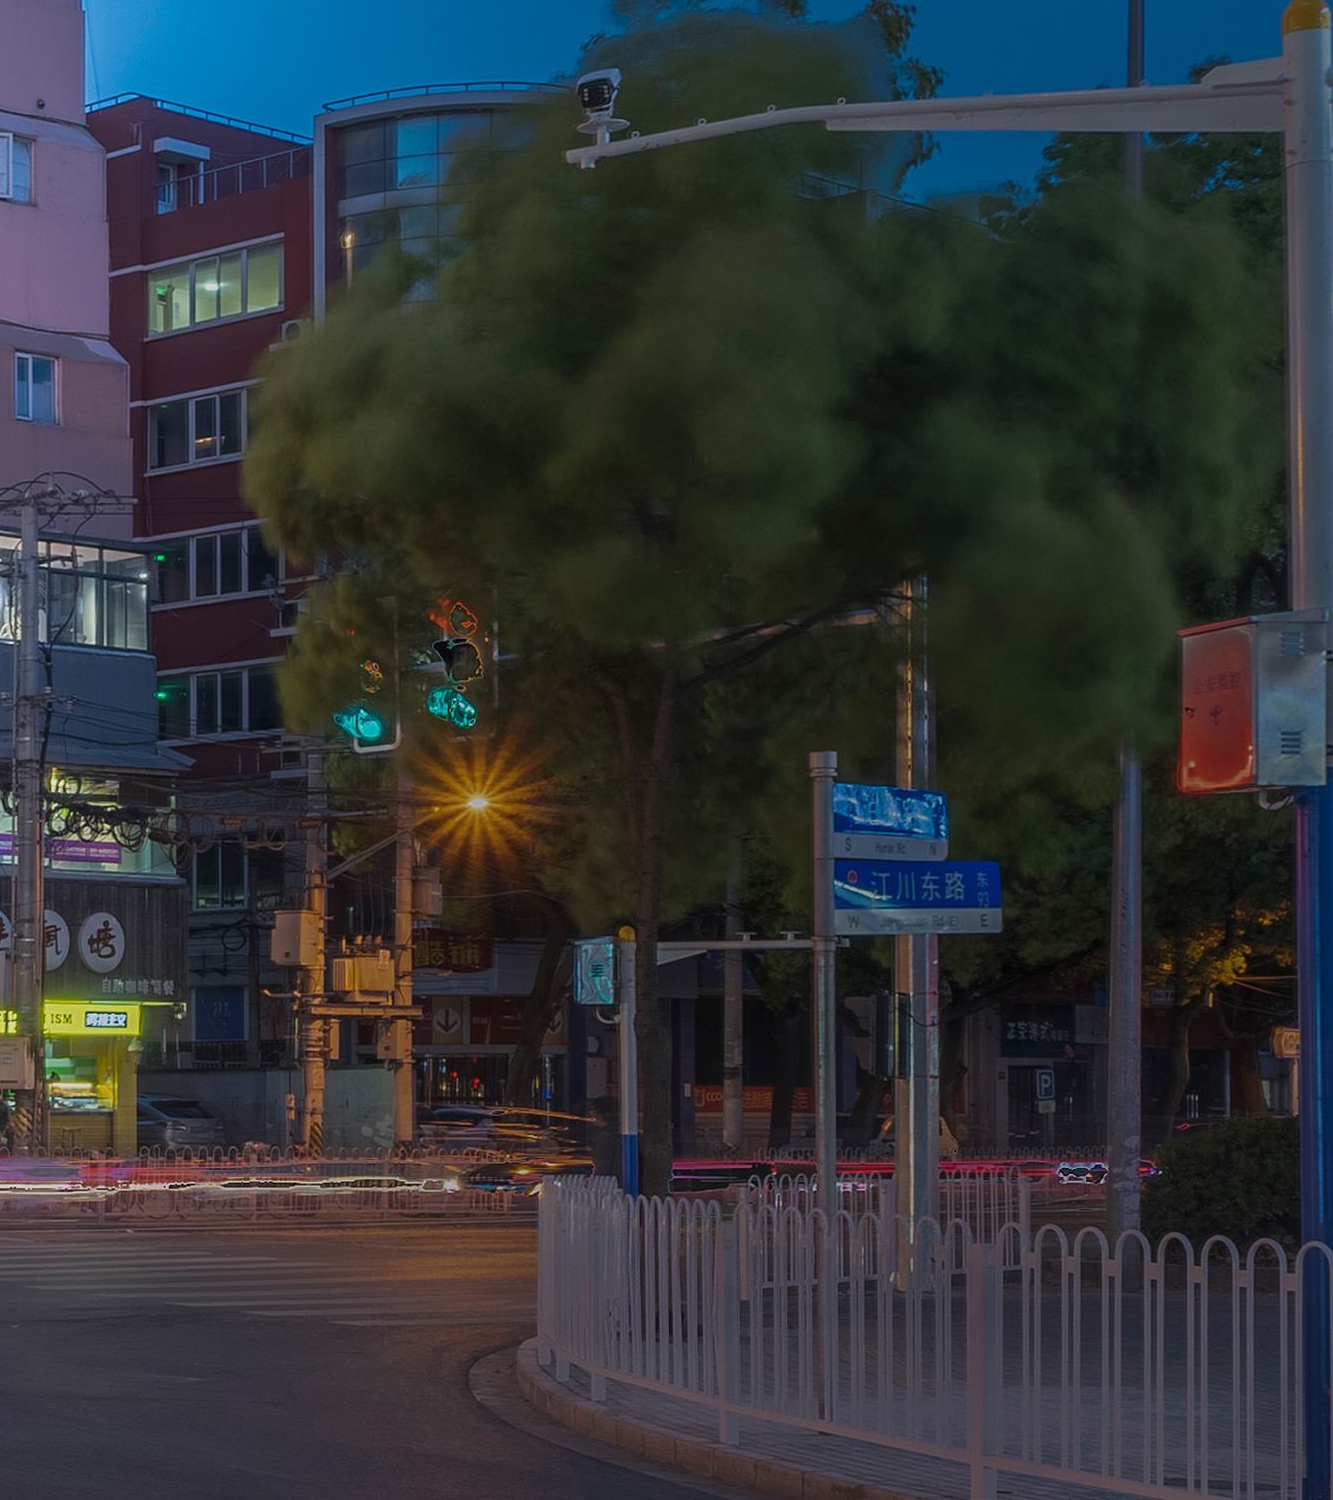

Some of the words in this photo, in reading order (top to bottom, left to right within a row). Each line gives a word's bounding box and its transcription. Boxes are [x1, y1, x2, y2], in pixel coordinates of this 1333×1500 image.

[845, 837, 852, 852] S
[929, 842, 937, 855] N
[870, 870, 966, 902] 江川东路
[976, 870, 989, 888] 东
[848, 916, 859, 928] W
[981, 914, 989, 927] E
[1040, 1074, 1051, 1096] P
